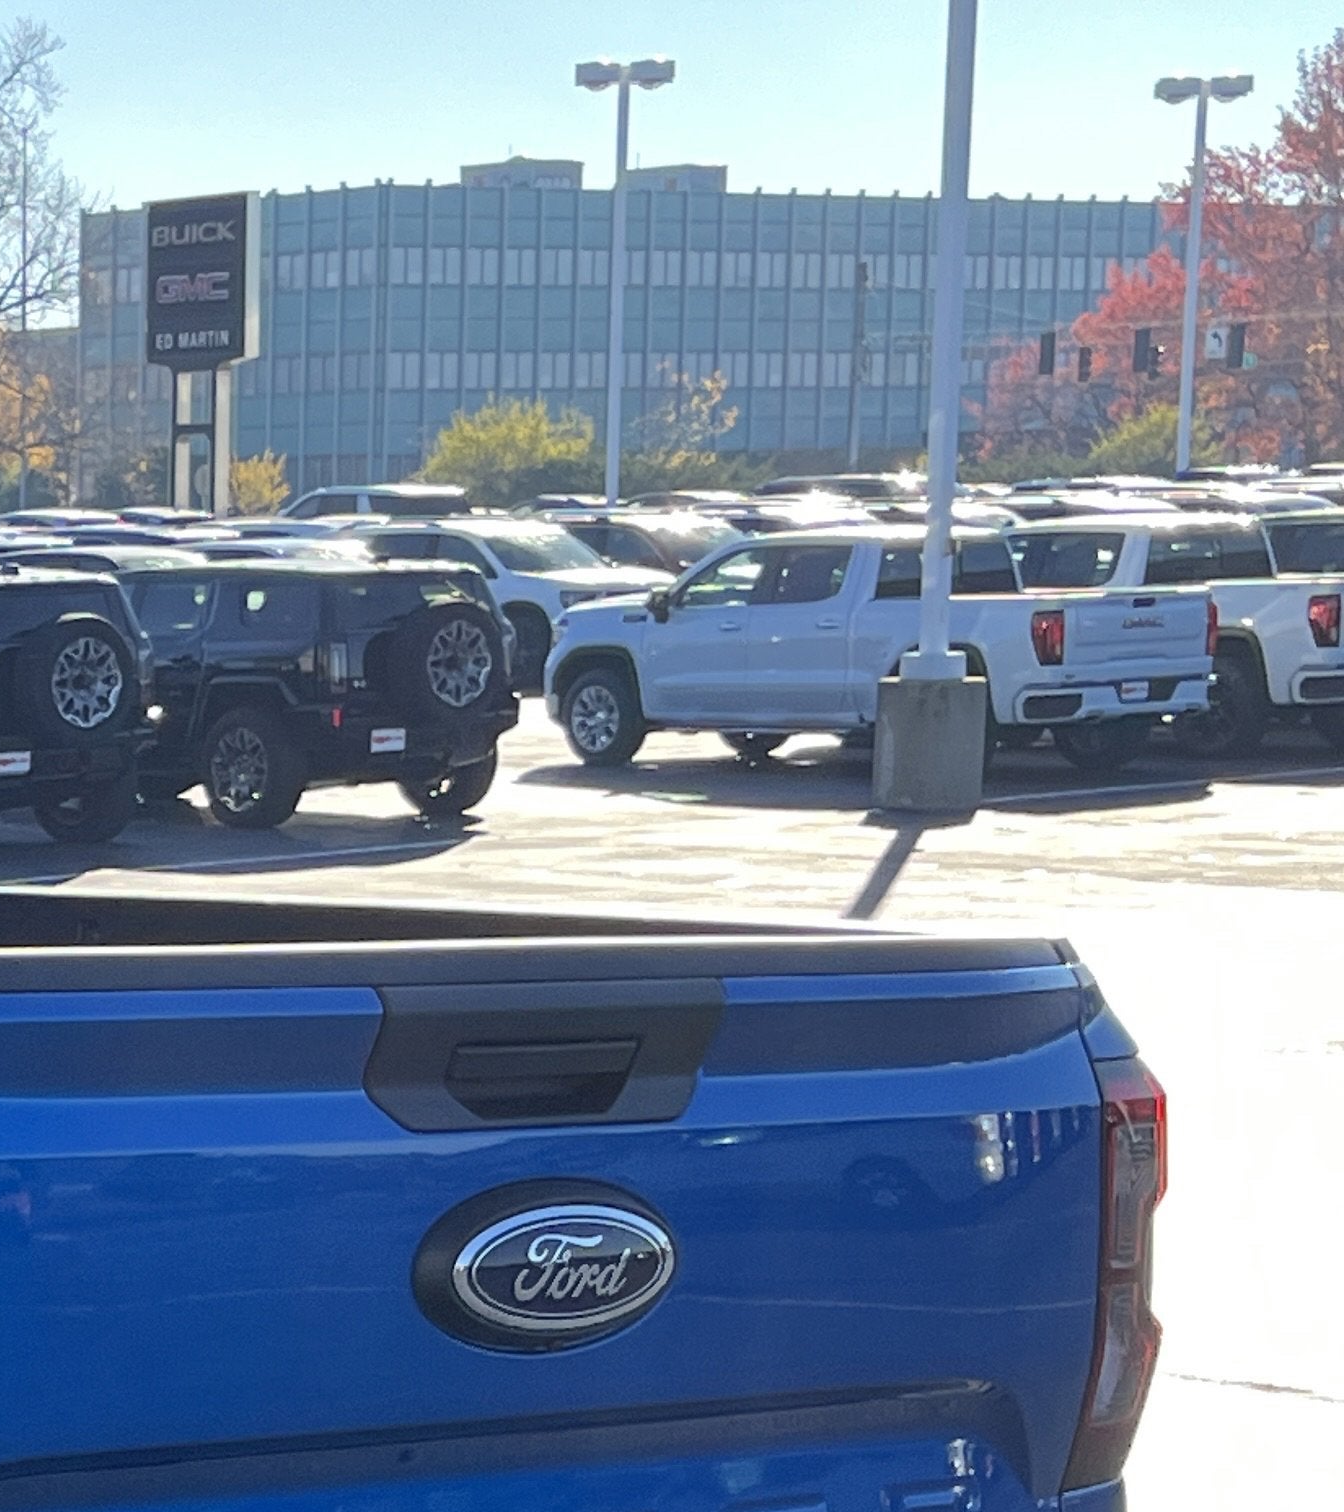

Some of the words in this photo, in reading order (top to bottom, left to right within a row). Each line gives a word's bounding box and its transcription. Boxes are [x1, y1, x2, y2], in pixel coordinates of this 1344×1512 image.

[150, 219, 236, 248] BUICK
[155, 271, 230, 303] GMC
[155, 333, 173, 350] ED
[178, 329, 230, 349] MARTIN
[514, 1233, 630, 1300] Ford
